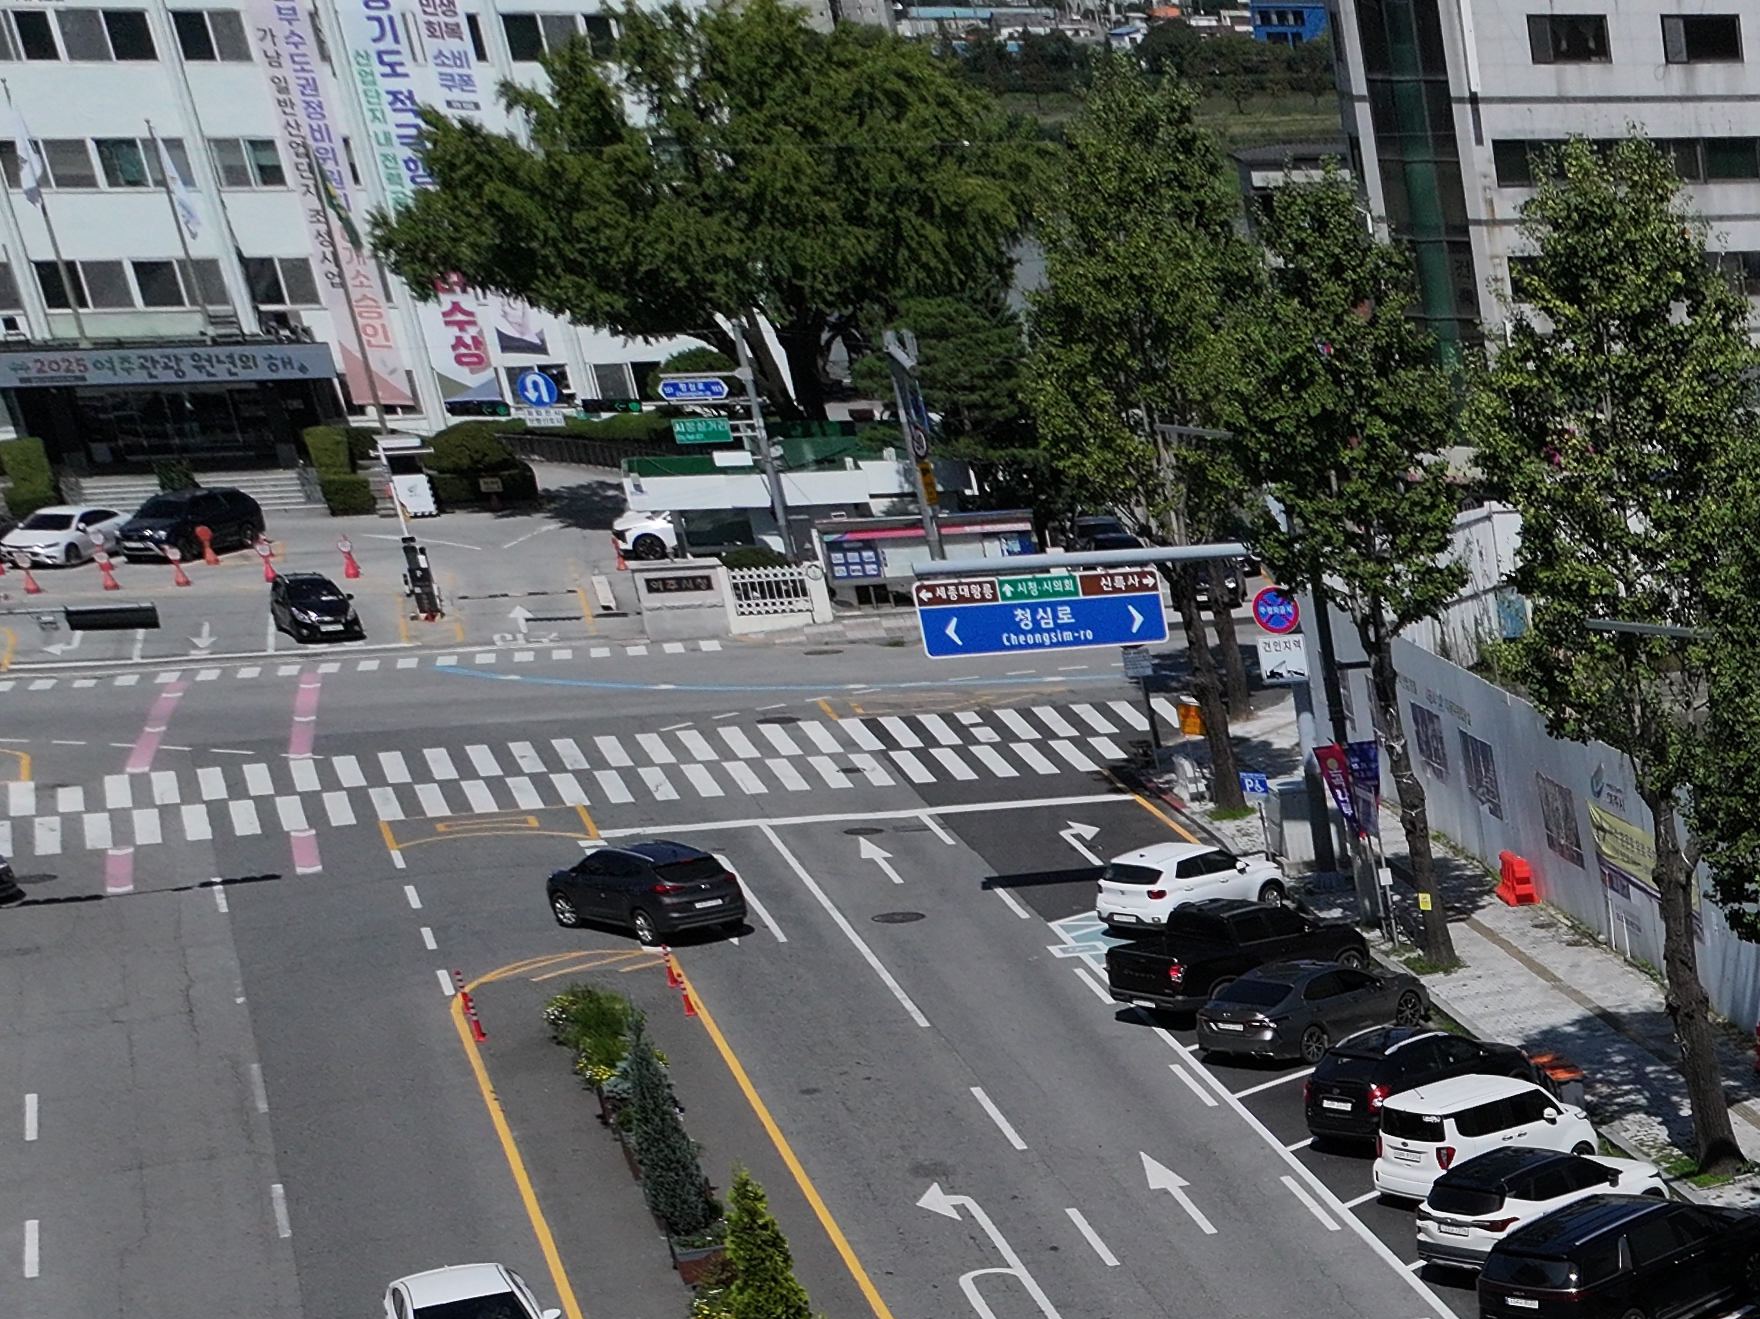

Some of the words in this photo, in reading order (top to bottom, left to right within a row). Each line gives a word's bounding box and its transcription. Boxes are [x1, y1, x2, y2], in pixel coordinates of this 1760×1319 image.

[426, 20, 464, 41] 회복
[257, 27, 284, 69] 가남
[433, 48, 472, 70] 소비
[438, 72, 478, 95] 쿠폰
[355, 294, 393, 349] 승인
[32, 357, 88, 374] 2025
[262, 353, 296, 374] 해
[935, 583, 995, 601] 세종대왕릉
[1100, 573, 1140, 591] 신륵사
[1014, 605, 1075, 631] 청심로
[1002, 629, 1094, 646] Cheongsim-ro
[1262, 639, 1302, 652] 견인지역
[1245, 778, 1256, 792] P
